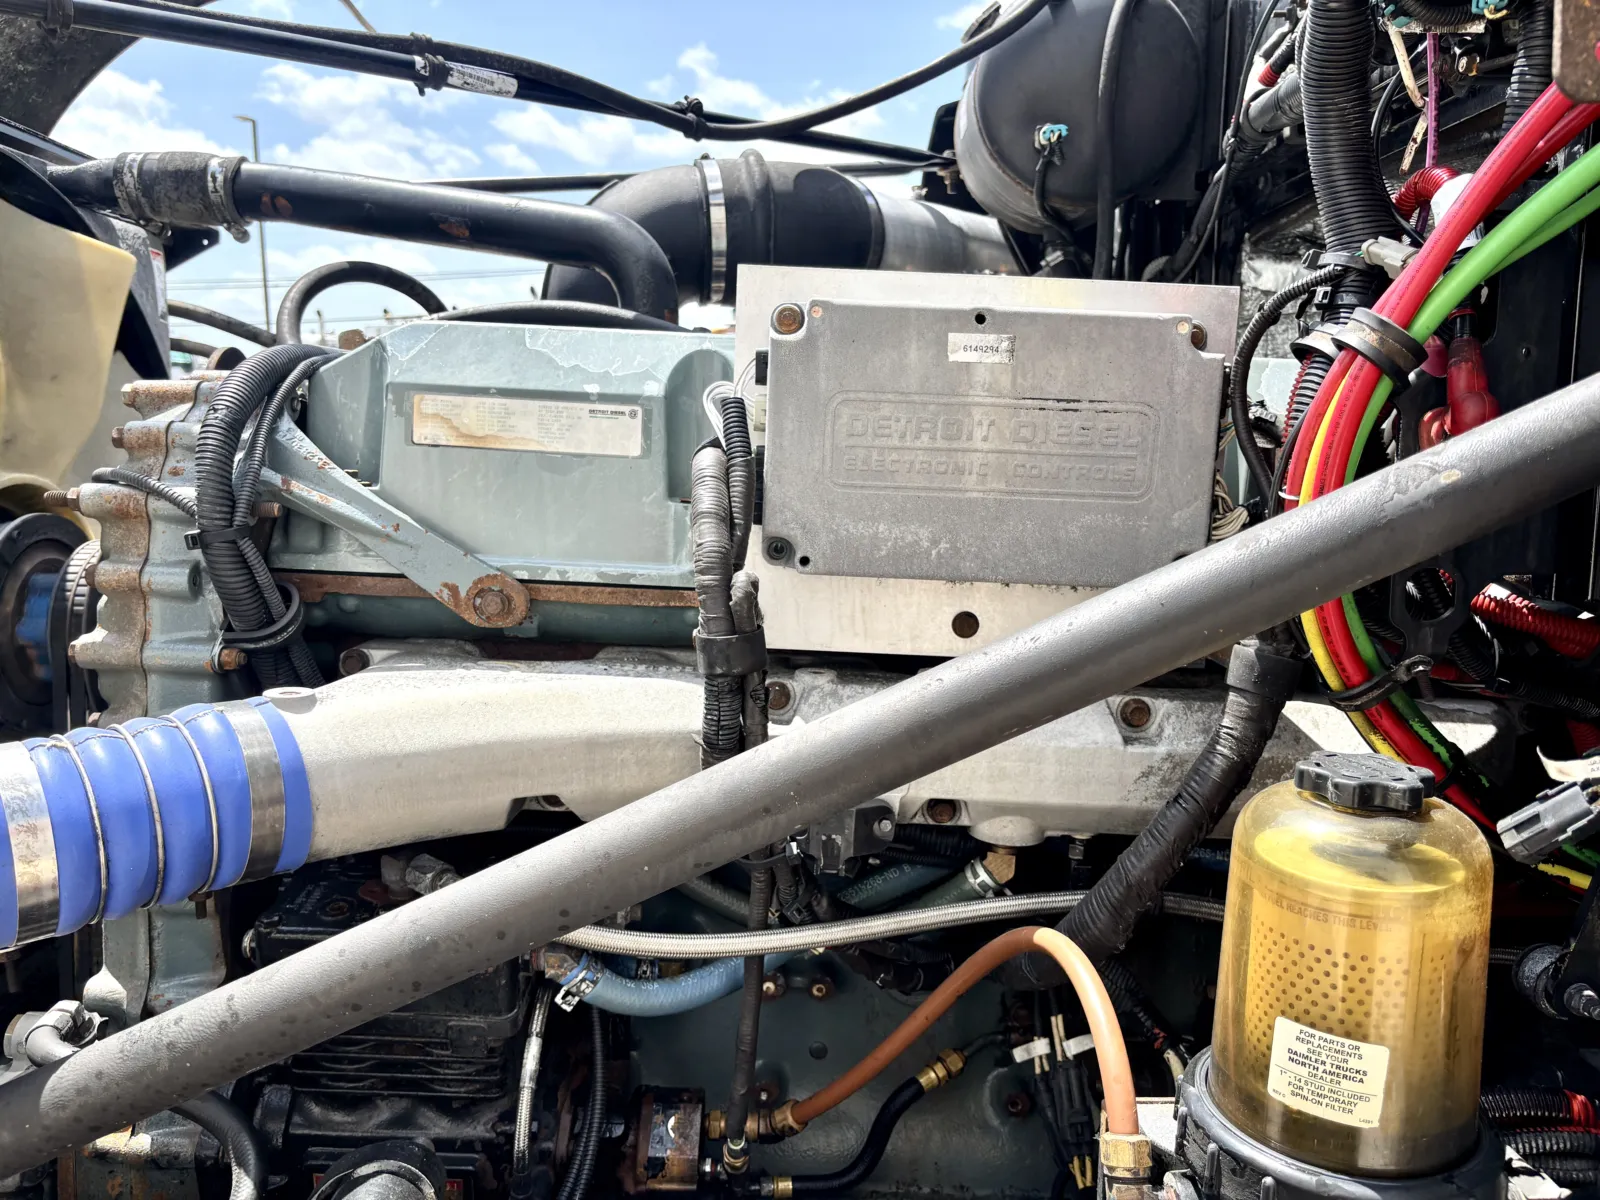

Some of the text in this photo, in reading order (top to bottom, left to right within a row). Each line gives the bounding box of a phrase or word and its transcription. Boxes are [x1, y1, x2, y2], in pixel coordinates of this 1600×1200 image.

[963, 345, 999, 353] 6149294
[846, 414, 1142, 449] DETROIT DIESEL
[843, 455, 1137, 483] ELECTRONIC CONTROLS
[1286, 903, 1328, 924] REACHES
[1332, 915, 1356, 929] THIS
[1295, 1035, 1363, 1060] REPLACEMENTS
[1299, 1029, 1361, 1052] FOR PARTS OR
[1287, 1047, 1368, 1076] DAIMLER TRUCKS
[1307, 1047, 1349, 1065] SEE YOUR
[1288, 1055, 1364, 1084] NORTH AMERICA
[1307, 1070, 1341, 1086] DEALER
[1288, 1081, 1358, 1108] FOR TEMPORARY
[1290, 1089, 1354, 1115] SPIN-ON FILTER
[1294, 1075, 1302, 1084] 14
[1303, 1079, 1326, 1092] STUD
[1327, 1087, 1371, 1103] INCLUDED
